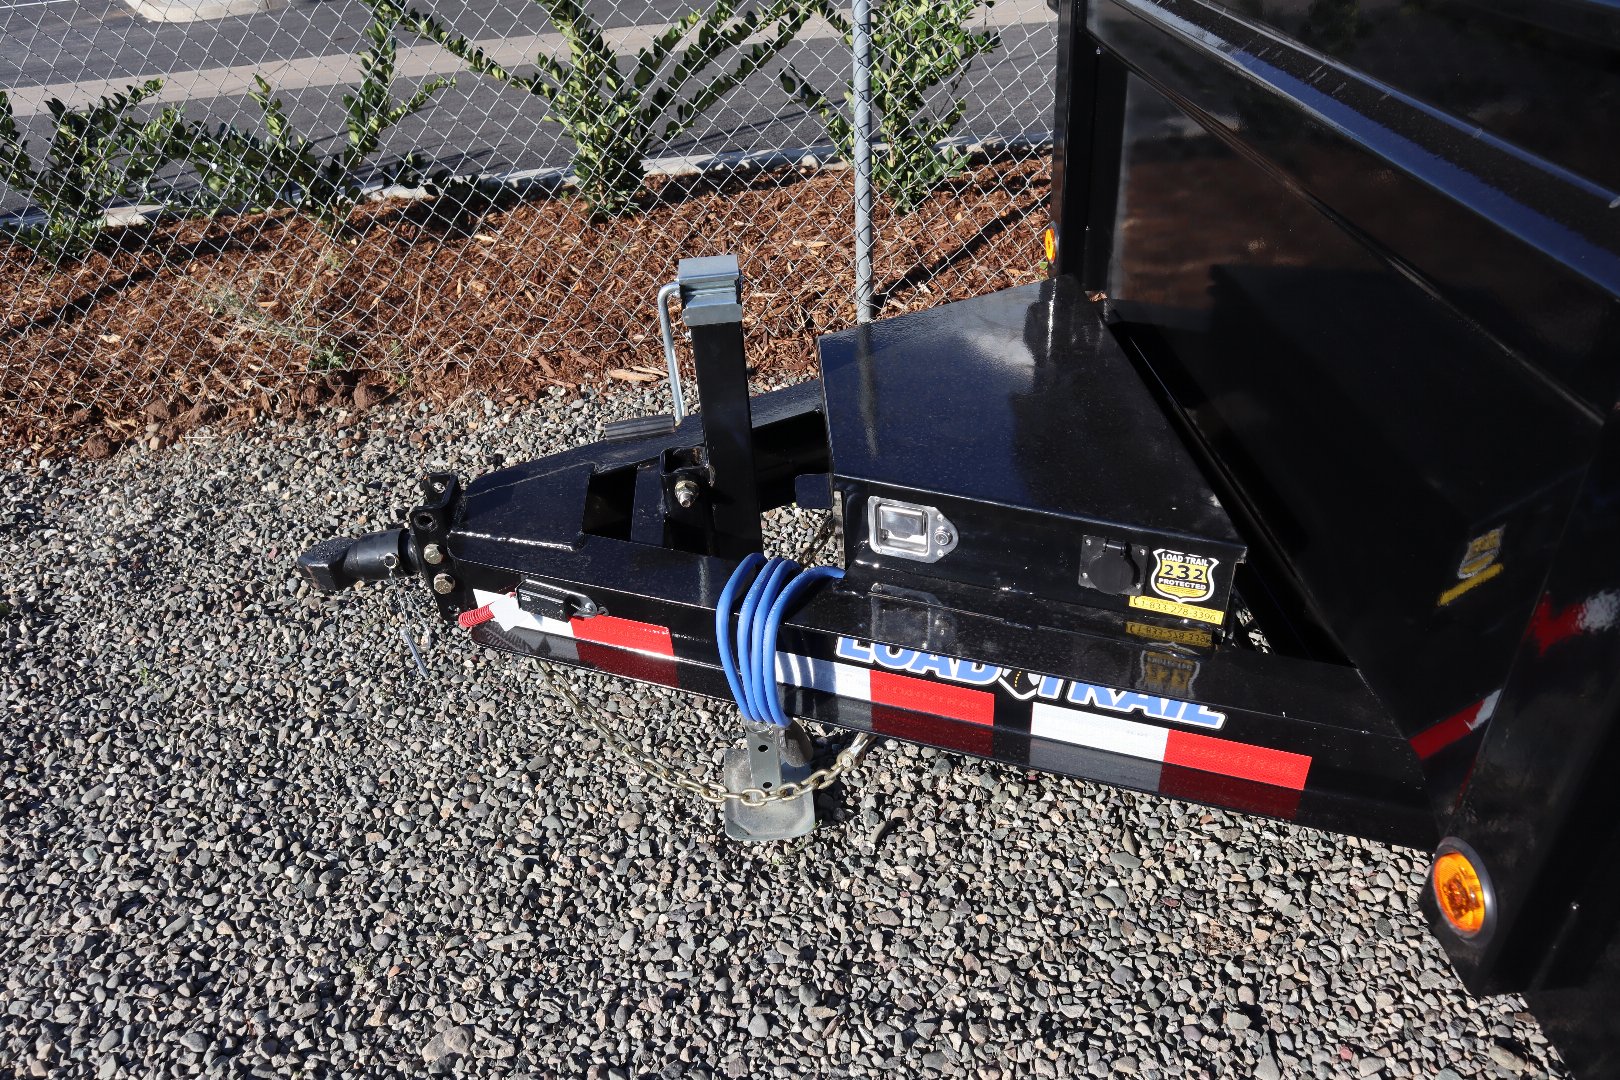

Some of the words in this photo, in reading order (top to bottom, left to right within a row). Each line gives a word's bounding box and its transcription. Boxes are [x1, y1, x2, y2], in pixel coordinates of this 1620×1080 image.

[1161, 552, 1184, 564] LOAD
[1185, 555, 1209, 567] TRAIL
[1163, 564, 1204, 581] 232
[1158, 577, 1206, 590] PROTECTED
